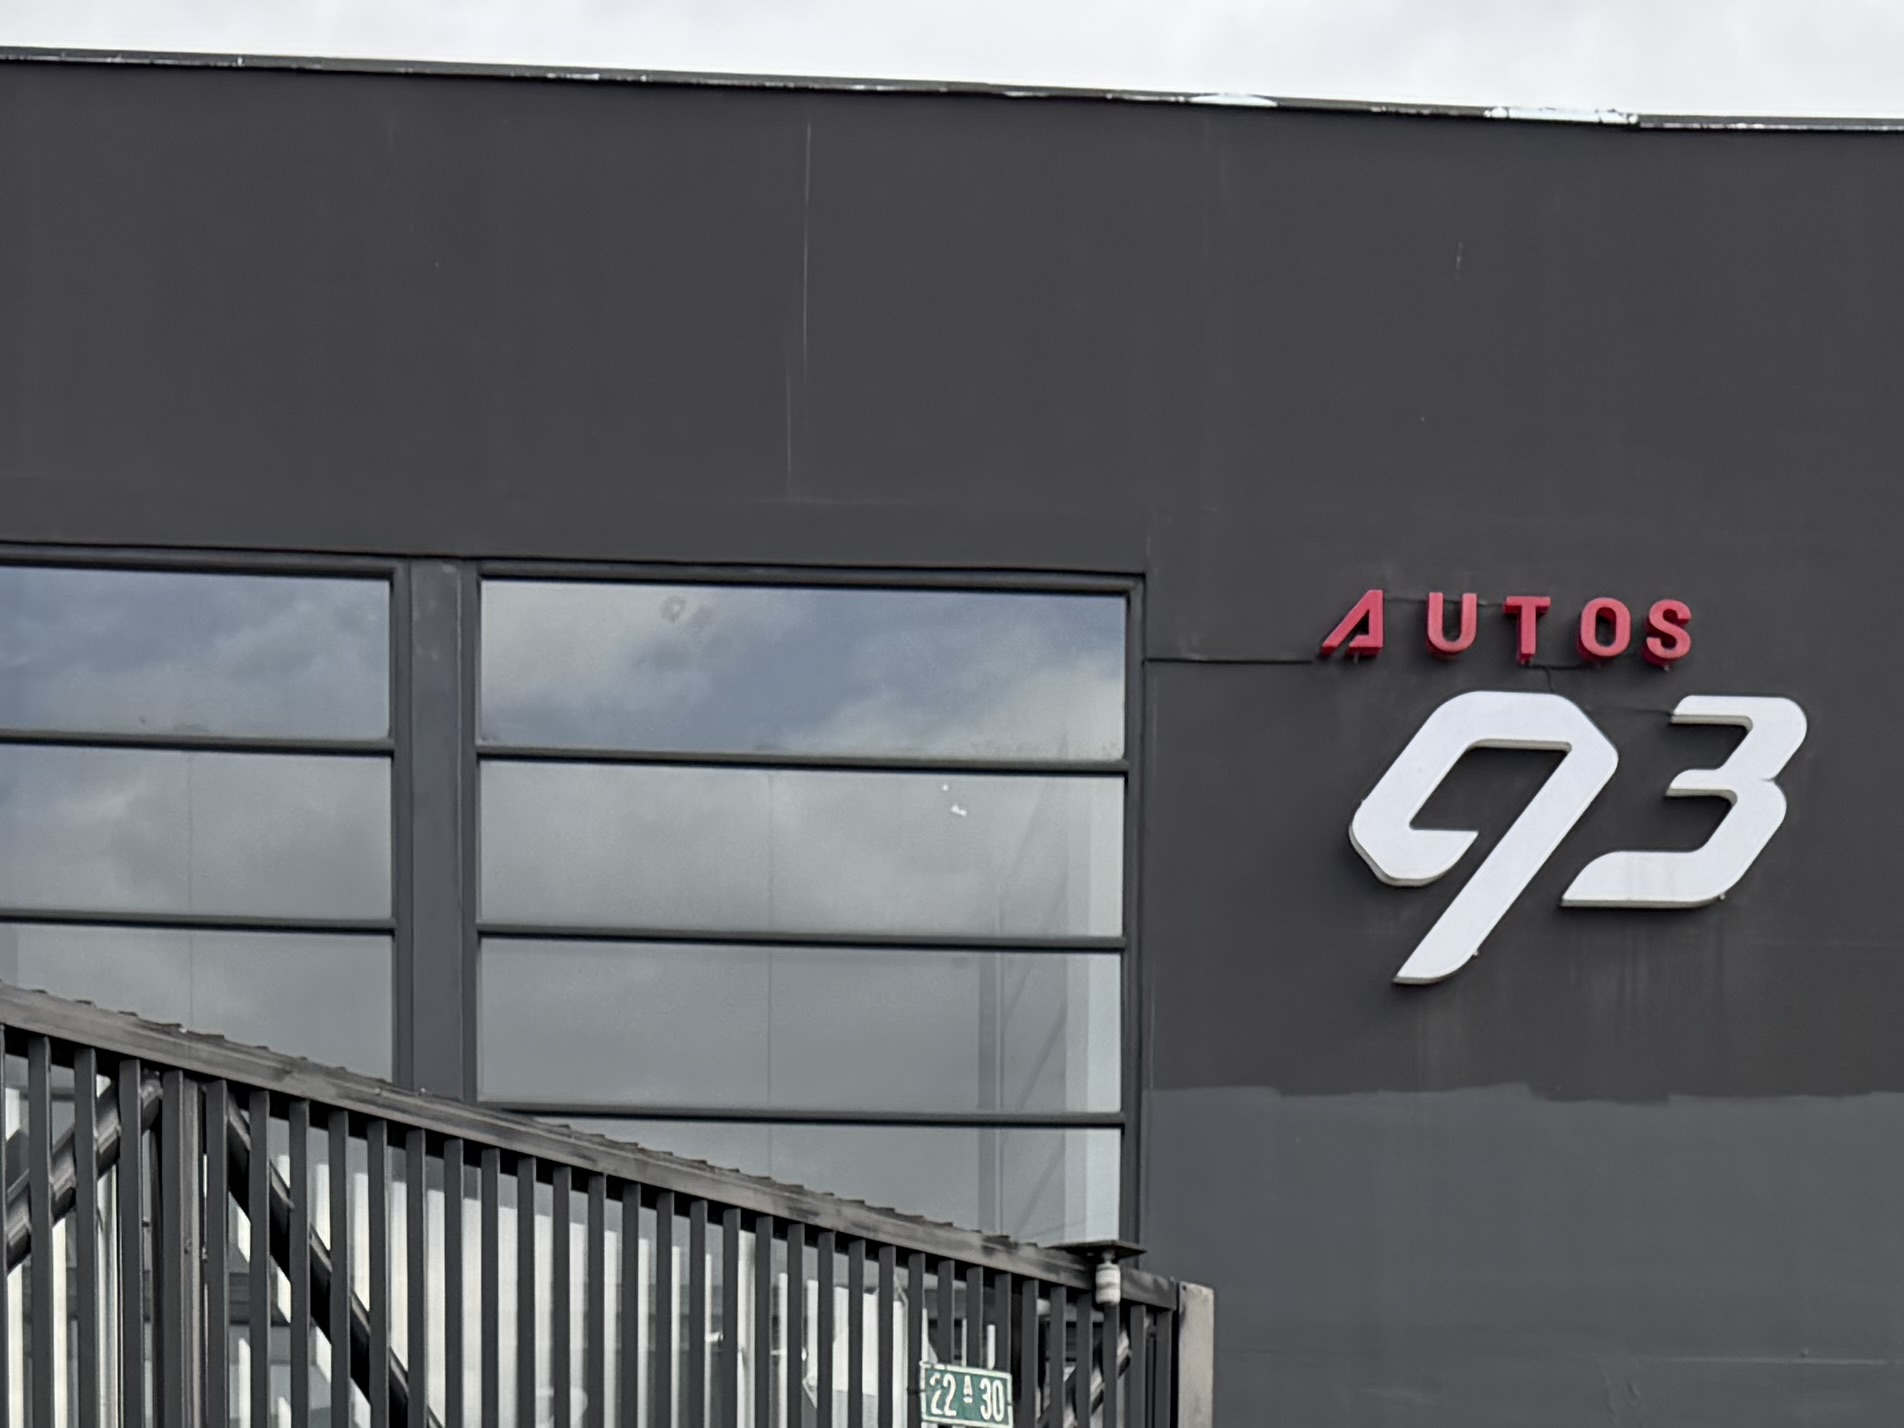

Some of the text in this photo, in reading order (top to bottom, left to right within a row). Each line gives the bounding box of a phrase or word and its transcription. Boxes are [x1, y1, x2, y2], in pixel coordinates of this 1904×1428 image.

[1319, 588, 1694, 668] AUTOS
[1349, 690, 1808, 984] 93
[979, 1377, 1005, 1422] 30
